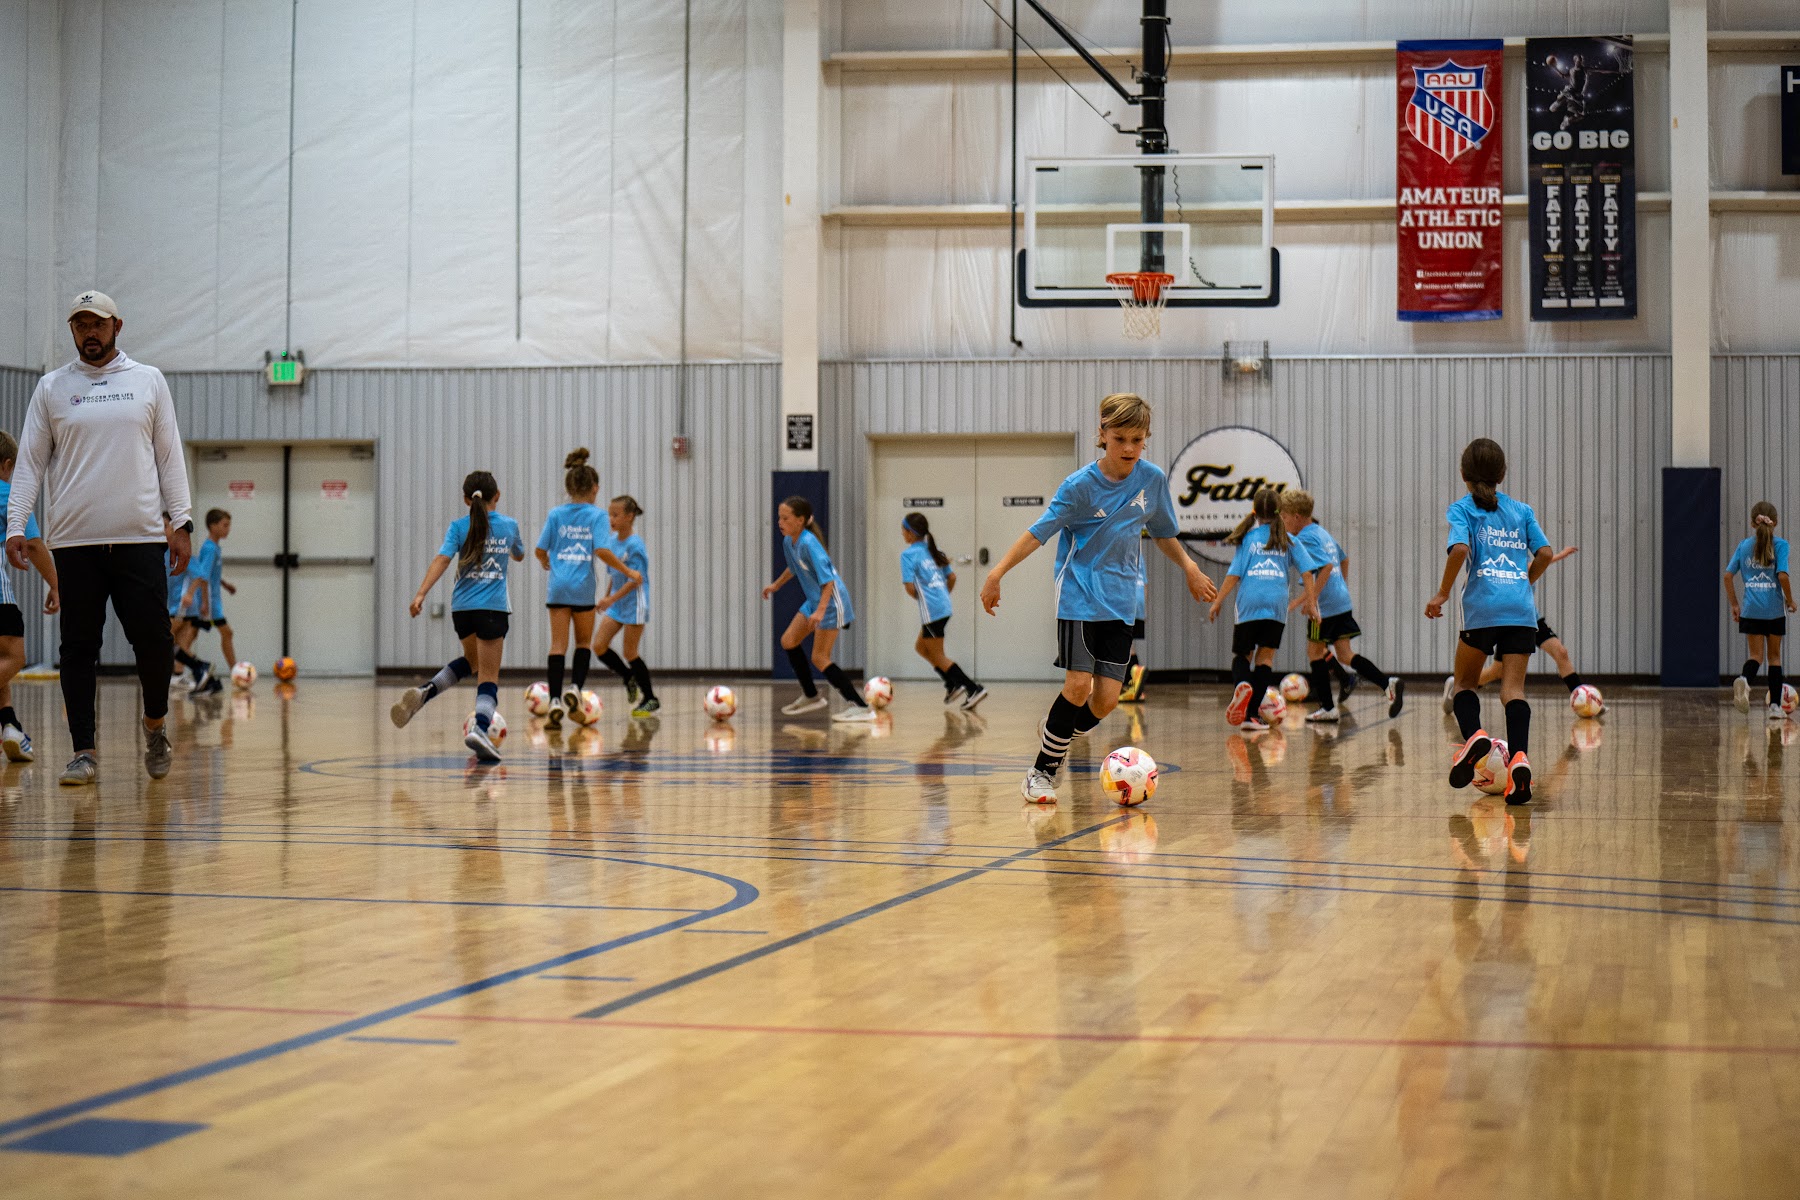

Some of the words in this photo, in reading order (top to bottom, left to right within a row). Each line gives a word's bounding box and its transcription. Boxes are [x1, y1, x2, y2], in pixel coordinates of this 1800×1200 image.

[1427, 74, 1472, 85] AAU
[1425, 94, 1472, 138] USA
[1532, 131, 1572, 150] GO
[1579, 129, 1629, 149] BIG
[1399, 187, 1501, 205] AMATEUR
[1400, 209, 1501, 228] ATHLETIC
[1546, 185, 1561, 252] FATTY
[1574, 184, 1590, 252] FATTY
[1603, 183, 1619, 251] FATTY
[1417, 231, 1483, 249] UNION
[1488, 525, 1509, 538] Bank
[1509, 528, 1520, 539] of
[498, 537, 508, 546] of
[1487, 536, 1527, 550] Colorado
[1247, 569, 1285, 578] SCHEELS
[1477, 568, 1528, 580] SCHEELS
